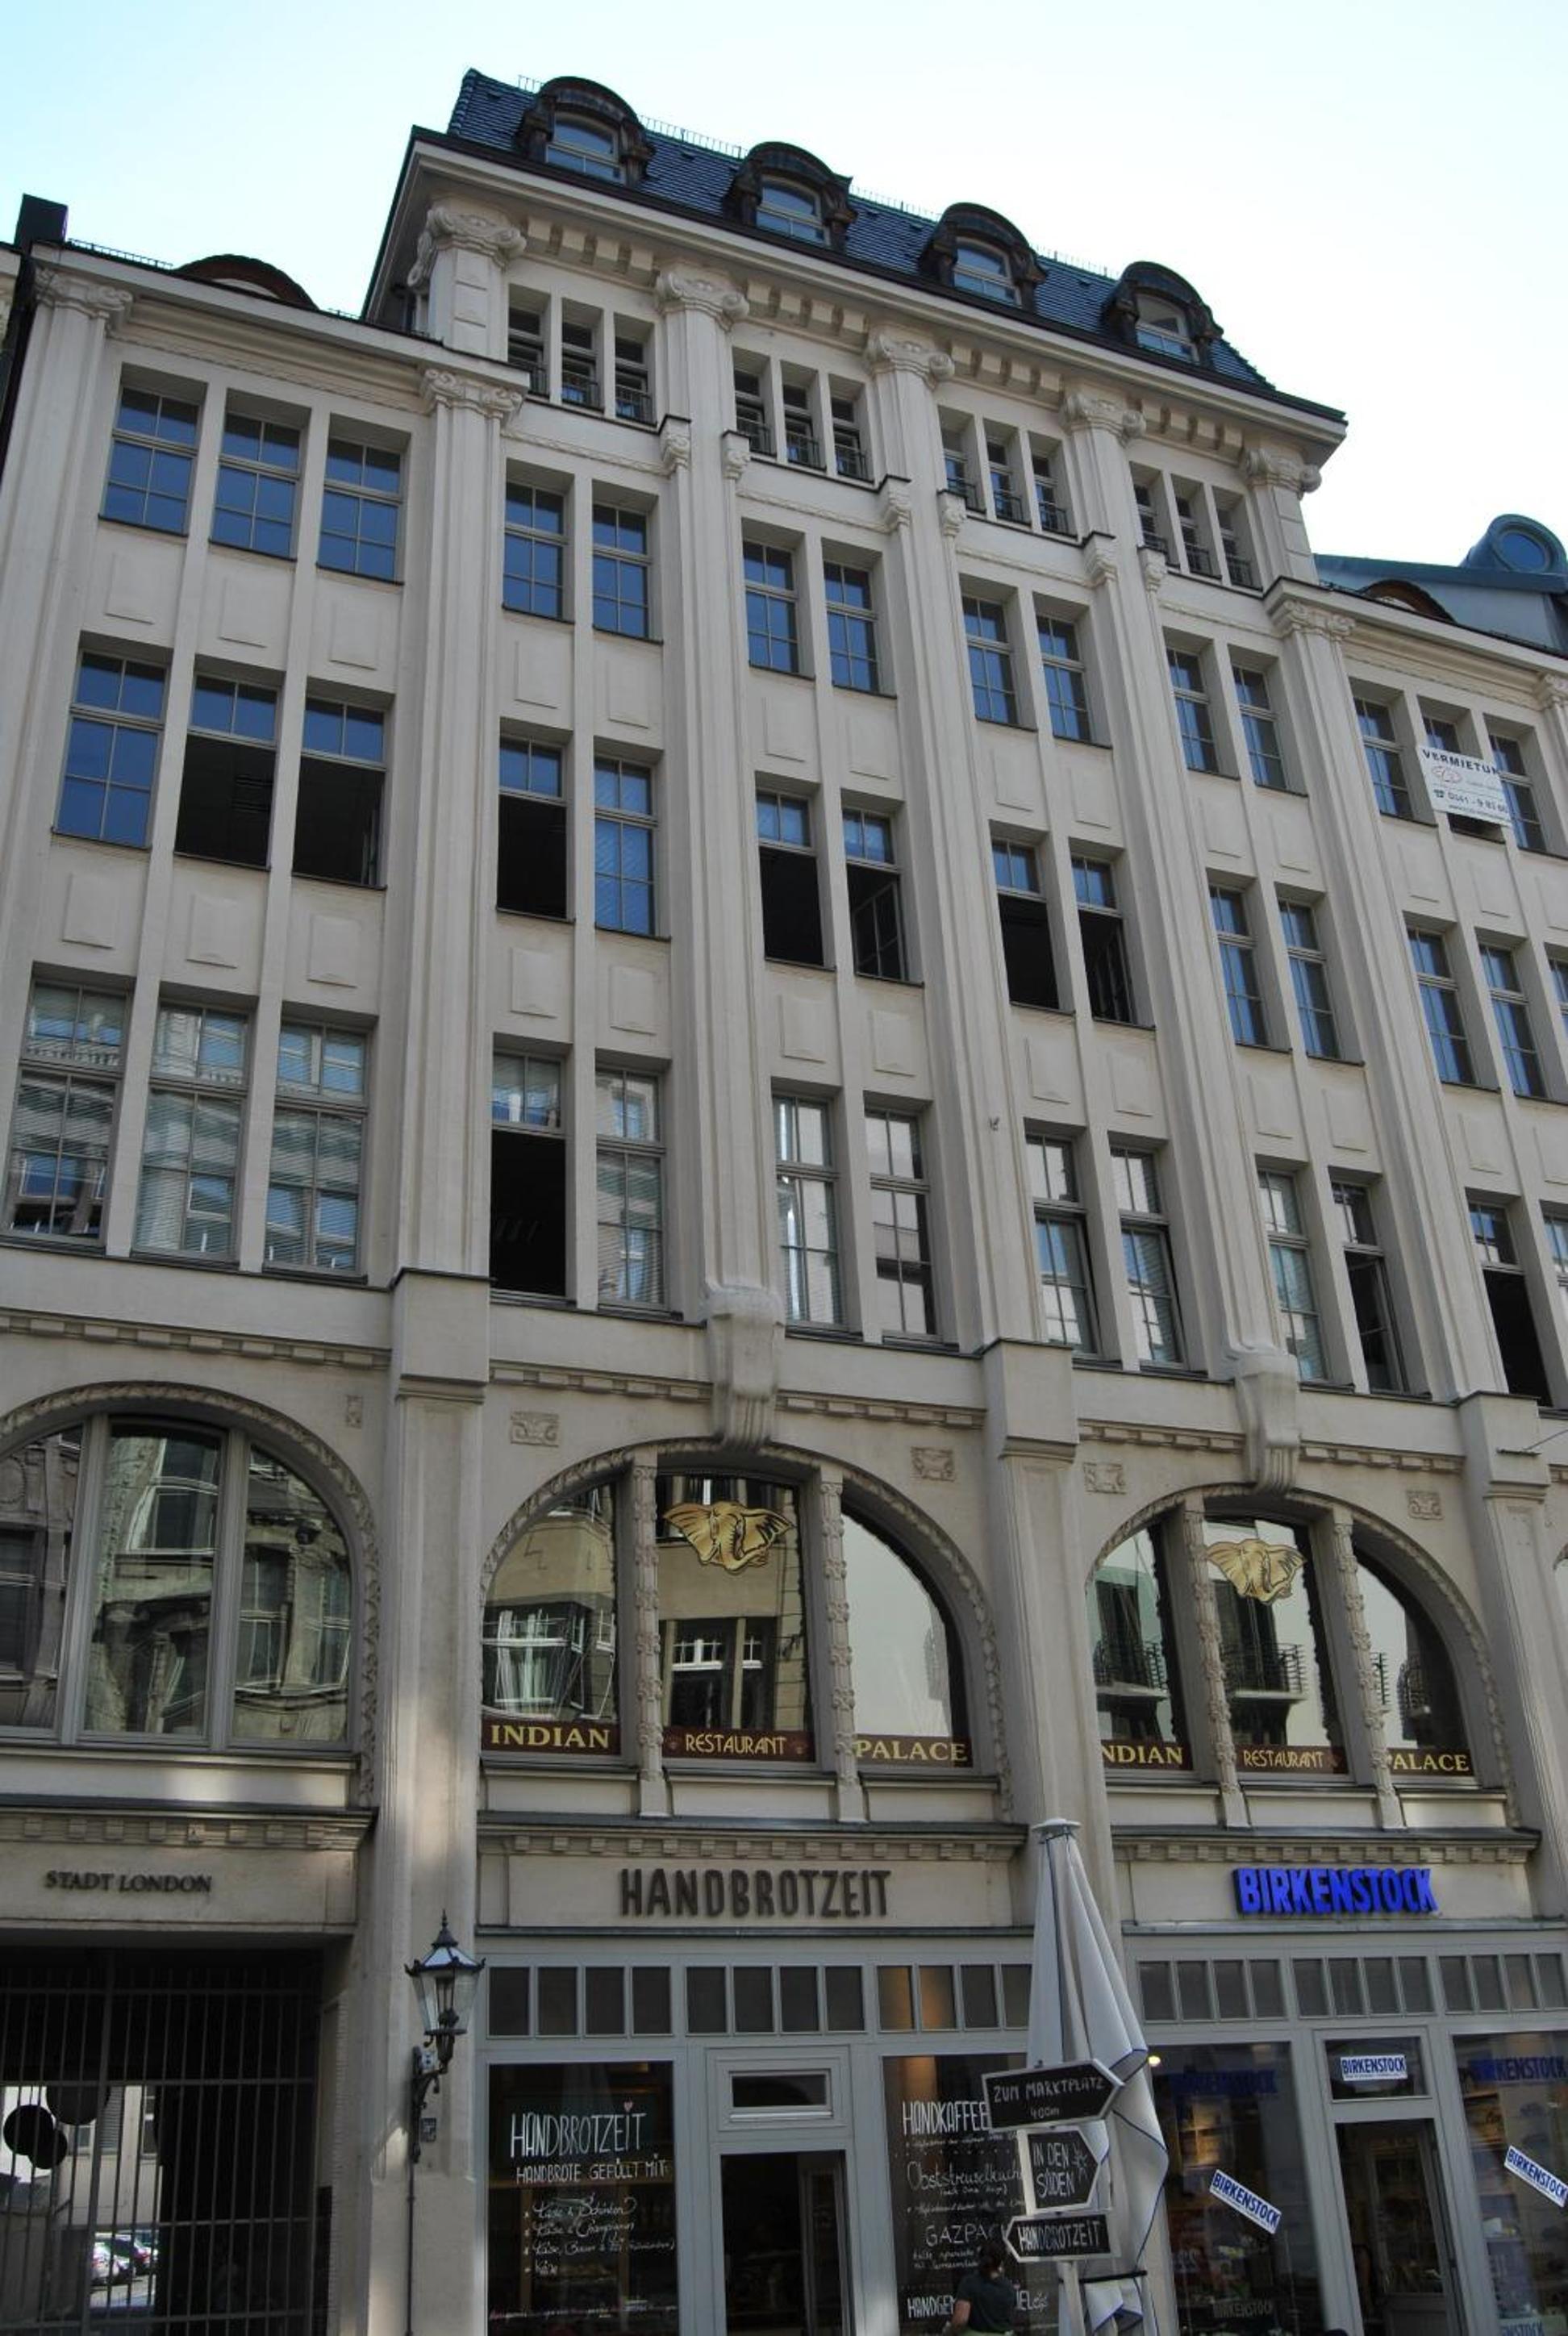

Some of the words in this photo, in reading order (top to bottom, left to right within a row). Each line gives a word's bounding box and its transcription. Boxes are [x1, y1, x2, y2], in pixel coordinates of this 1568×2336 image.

[490, 1725, 610, 1749] INDIAN
[686, 1733, 787, 1754] RESTAURANT
[853, 1739, 968, 1762] PALACE
[1101, 1745, 1182, 1765] NDIAN
[1243, 1750, 1324, 1769] RESTAURANT
[44, 1870, 115, 1891] STADT
[119, 1875, 212, 1893] LONDON
[620, 1868, 891, 1917] HANDBROTZEIT
[1232, 1868, 1437, 1914] BIRKENSTOCK
[1341, 2057, 1405, 2074] BIRKENSTOCK
[994, 2084, 1020, 2103] ZUM
[1026, 2076, 1105, 2100] MARKTPLATZ
[510, 2104, 647, 2159] HANDBROTZEIT
[902, 2100, 990, 2136] HANDKAFFEE
[1032, 2143, 1044, 2167] IN
[1047, 2142, 1070, 2168] DEN
[516, 2163, 582, 2184] HANDBROTE
[1036, 2169, 1075, 2198] SÜDEN
[1213, 2173, 1280, 2229] BIRKENSTOCK
[1017, 2219, 1101, 2253] HANDBROTZEIT
